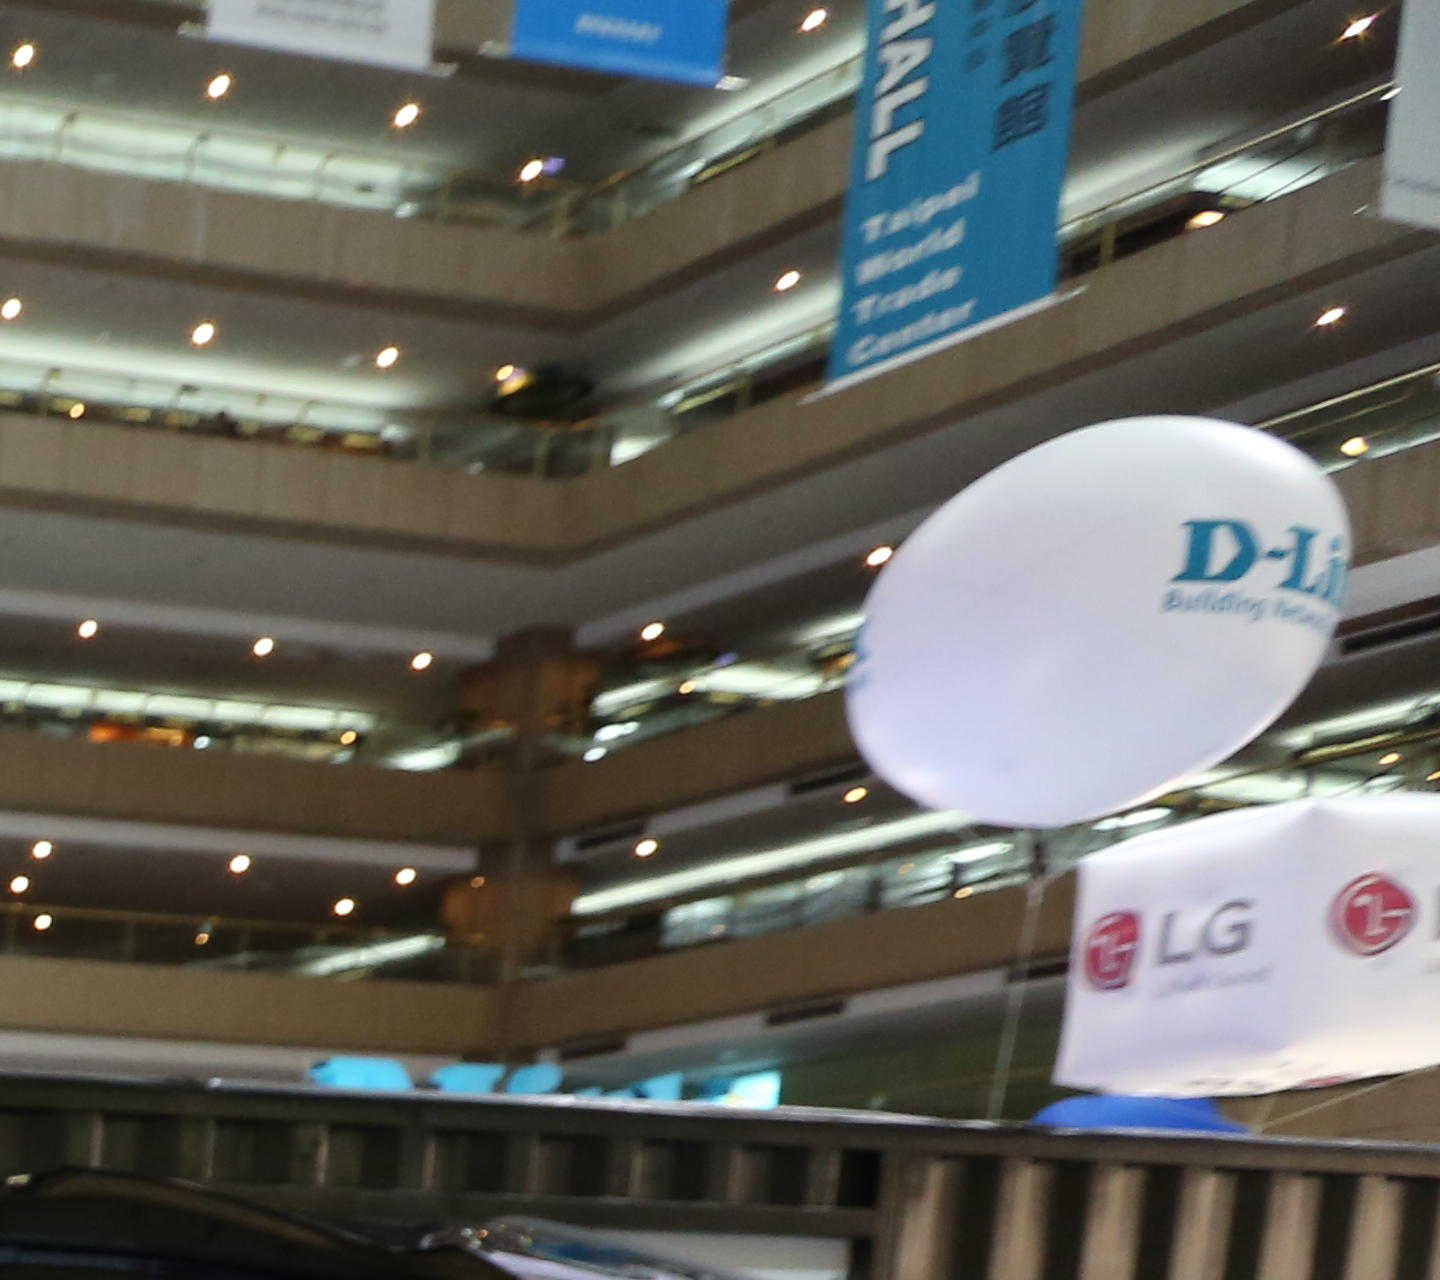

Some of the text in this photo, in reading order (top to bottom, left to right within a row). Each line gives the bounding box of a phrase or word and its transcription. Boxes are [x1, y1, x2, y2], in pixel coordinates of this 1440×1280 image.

[859, 169, 981, 244] Taipei
[855, 216, 966, 286] World
[851, 266, 963, 325] Trade
[846, 298, 979, 367] Center
[1168, 518, 1347, 604] D-Li
[1156, 898, 1257, 965] LG
